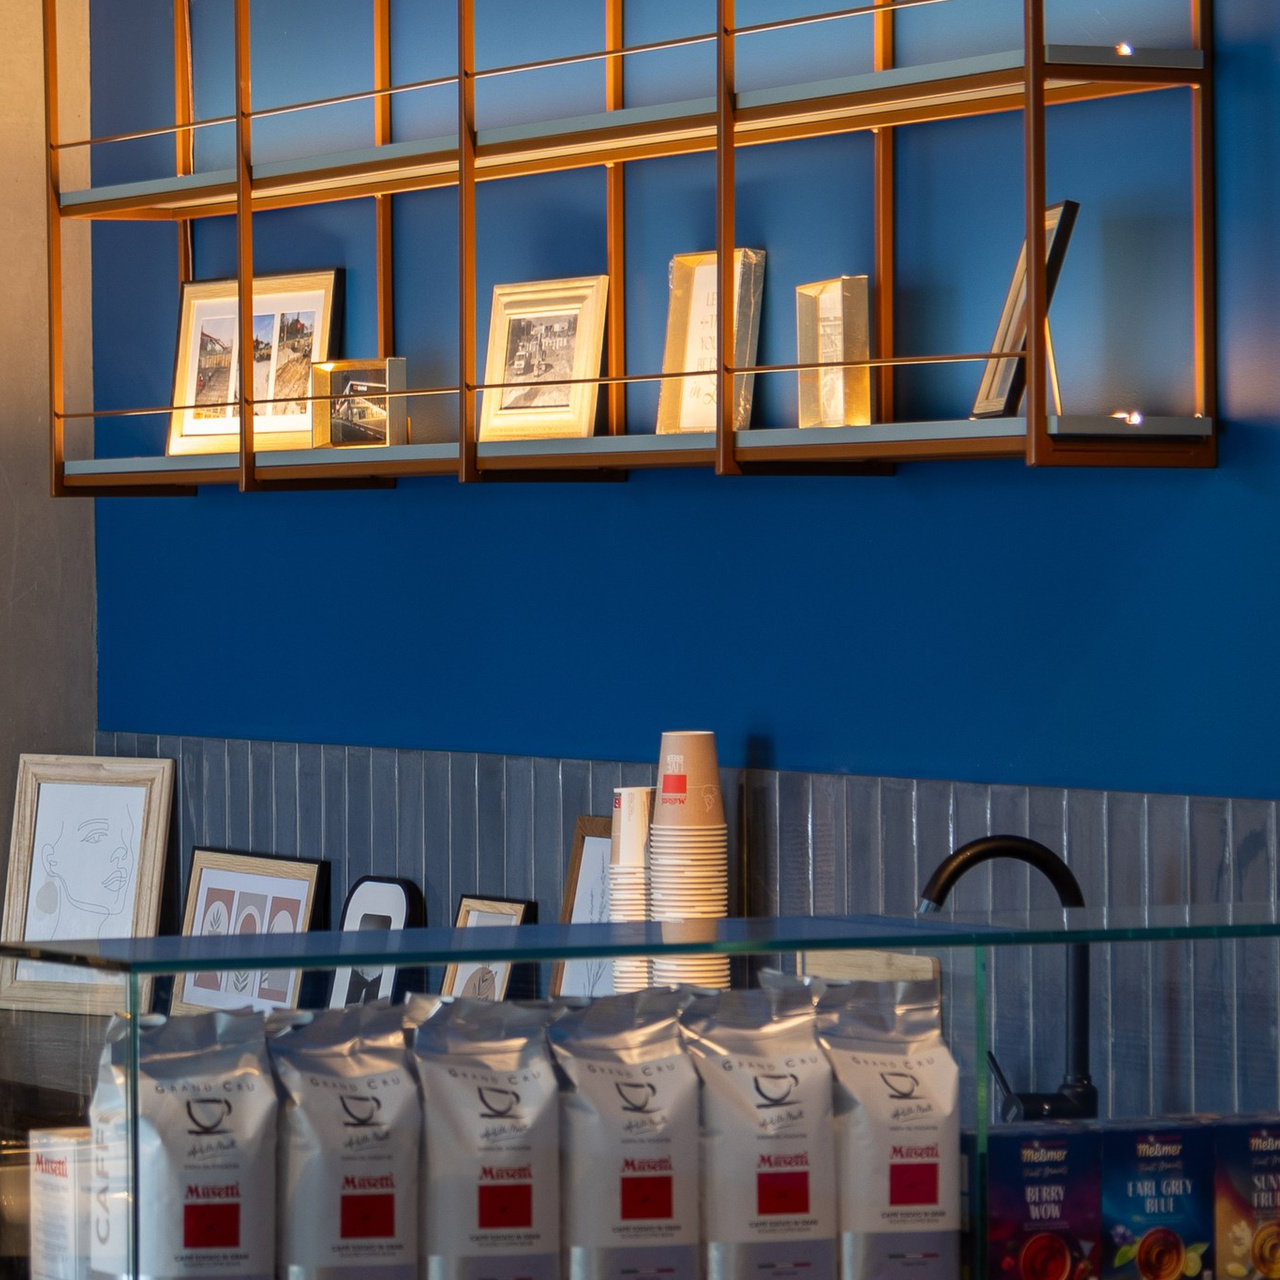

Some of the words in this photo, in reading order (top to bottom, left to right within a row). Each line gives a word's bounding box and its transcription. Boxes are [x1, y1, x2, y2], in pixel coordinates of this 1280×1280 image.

[889, 1143, 940, 1159] Musetti
[1021, 1148, 1068, 1162] Meßmer
[1136, 1143, 1182, 1158] Meßmer
[34, 1151, 69, 1179] Musetti
[621, 1155, 673, 1172] Musetti
[756, 1151, 810, 1168] Musetti
[479, 1163, 533, 1181] Musetti
[184, 1181, 241, 1199] Musetti
[341, 1173, 395, 1191] Musetti
[1127, 1180, 1156, 1197] EARL
[1161, 1178, 1193, 1195] GREY
[1025, 1185, 1065, 1202] BERRY
[1029, 1203, 1061, 1220] WOW
[1145, 1196, 1175, 1214] BLUE
